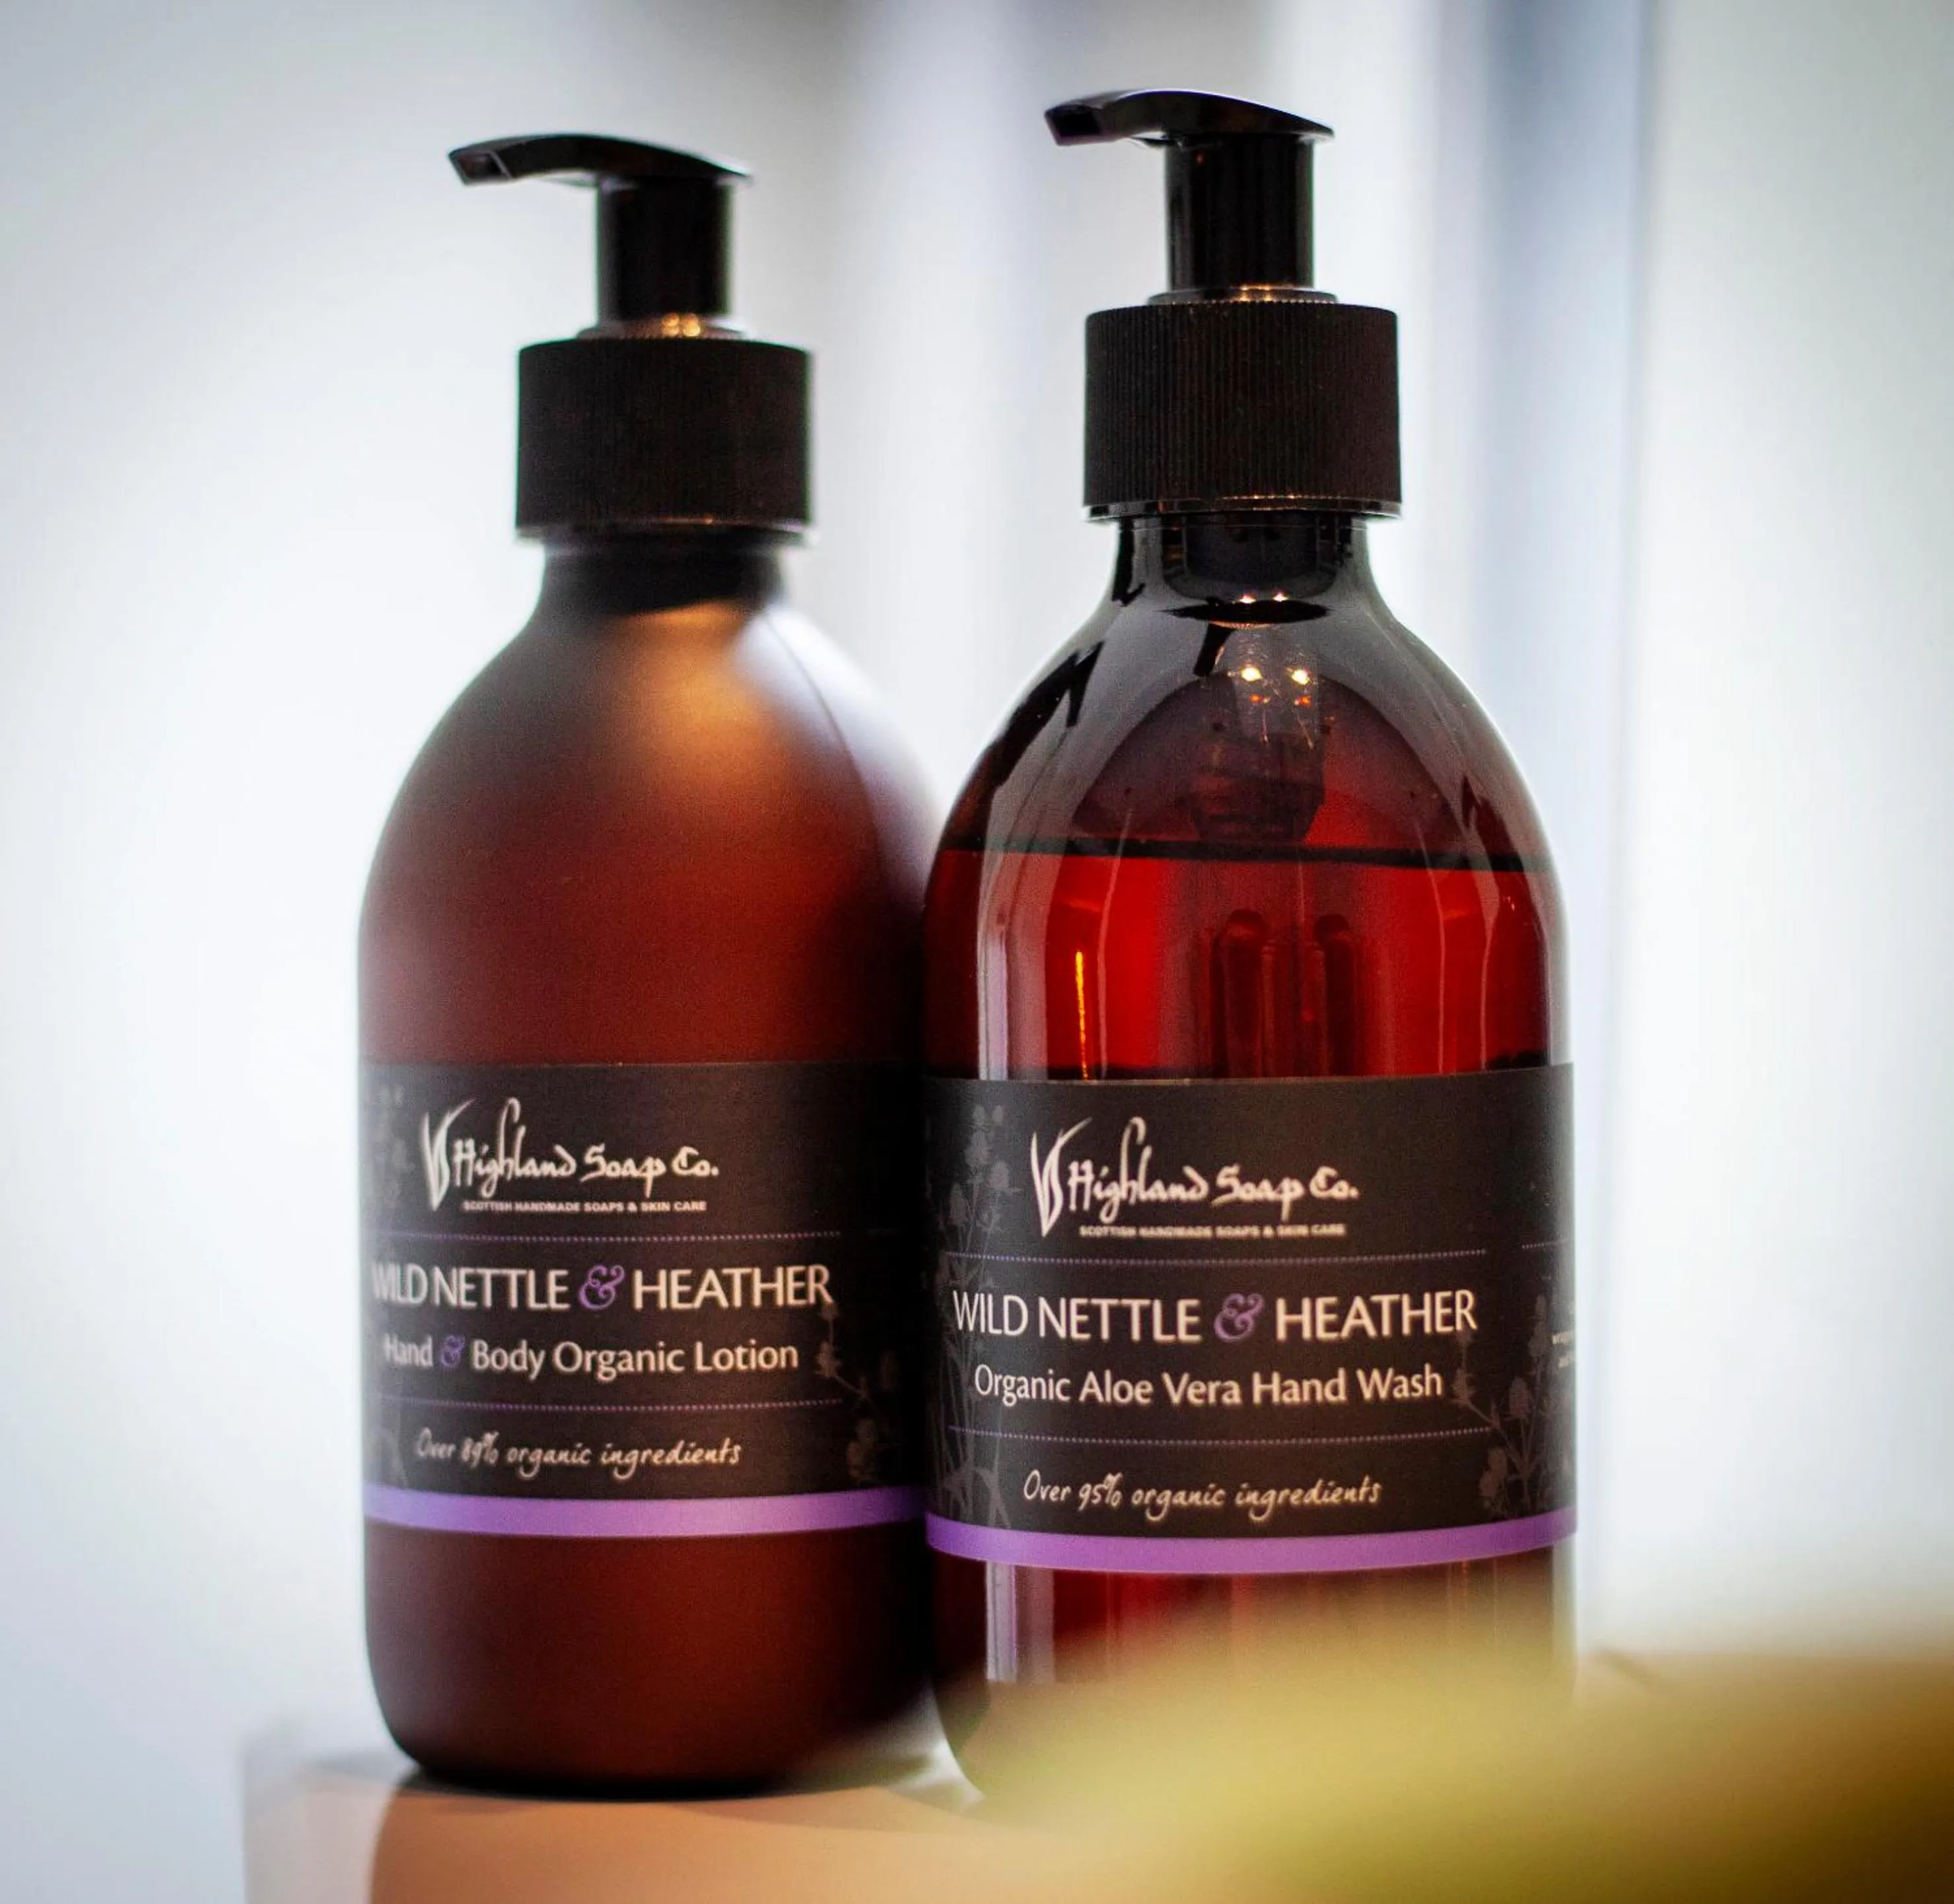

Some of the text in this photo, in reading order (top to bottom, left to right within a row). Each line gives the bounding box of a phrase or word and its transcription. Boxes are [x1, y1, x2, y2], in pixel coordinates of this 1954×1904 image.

[453, 1097, 719, 1198] Highland Soap Co.
[1067, 1116, 1360, 1223] Highland Soap Co.
[463, 1200, 707, 1213] SCOTTISH HANDMADE SOAPS & SKIN CARE
[372, 1262, 834, 1310] WILD NETTLE & HEATHER
[953, 1289, 1479, 1343] WILD NETTLE & HEATHER
[383, 1332, 799, 1382] Hand & Body Organic Lotion
[975, 1363, 1444, 1408] Organic Aloe Vera Hand Wash
[417, 1426, 456, 1460] Over
[506, 1443, 593, 1479] organic
[600, 1437, 742, 1481] ingredients
[1023, 1469, 1383, 1522] Over 95% organic ingredients
